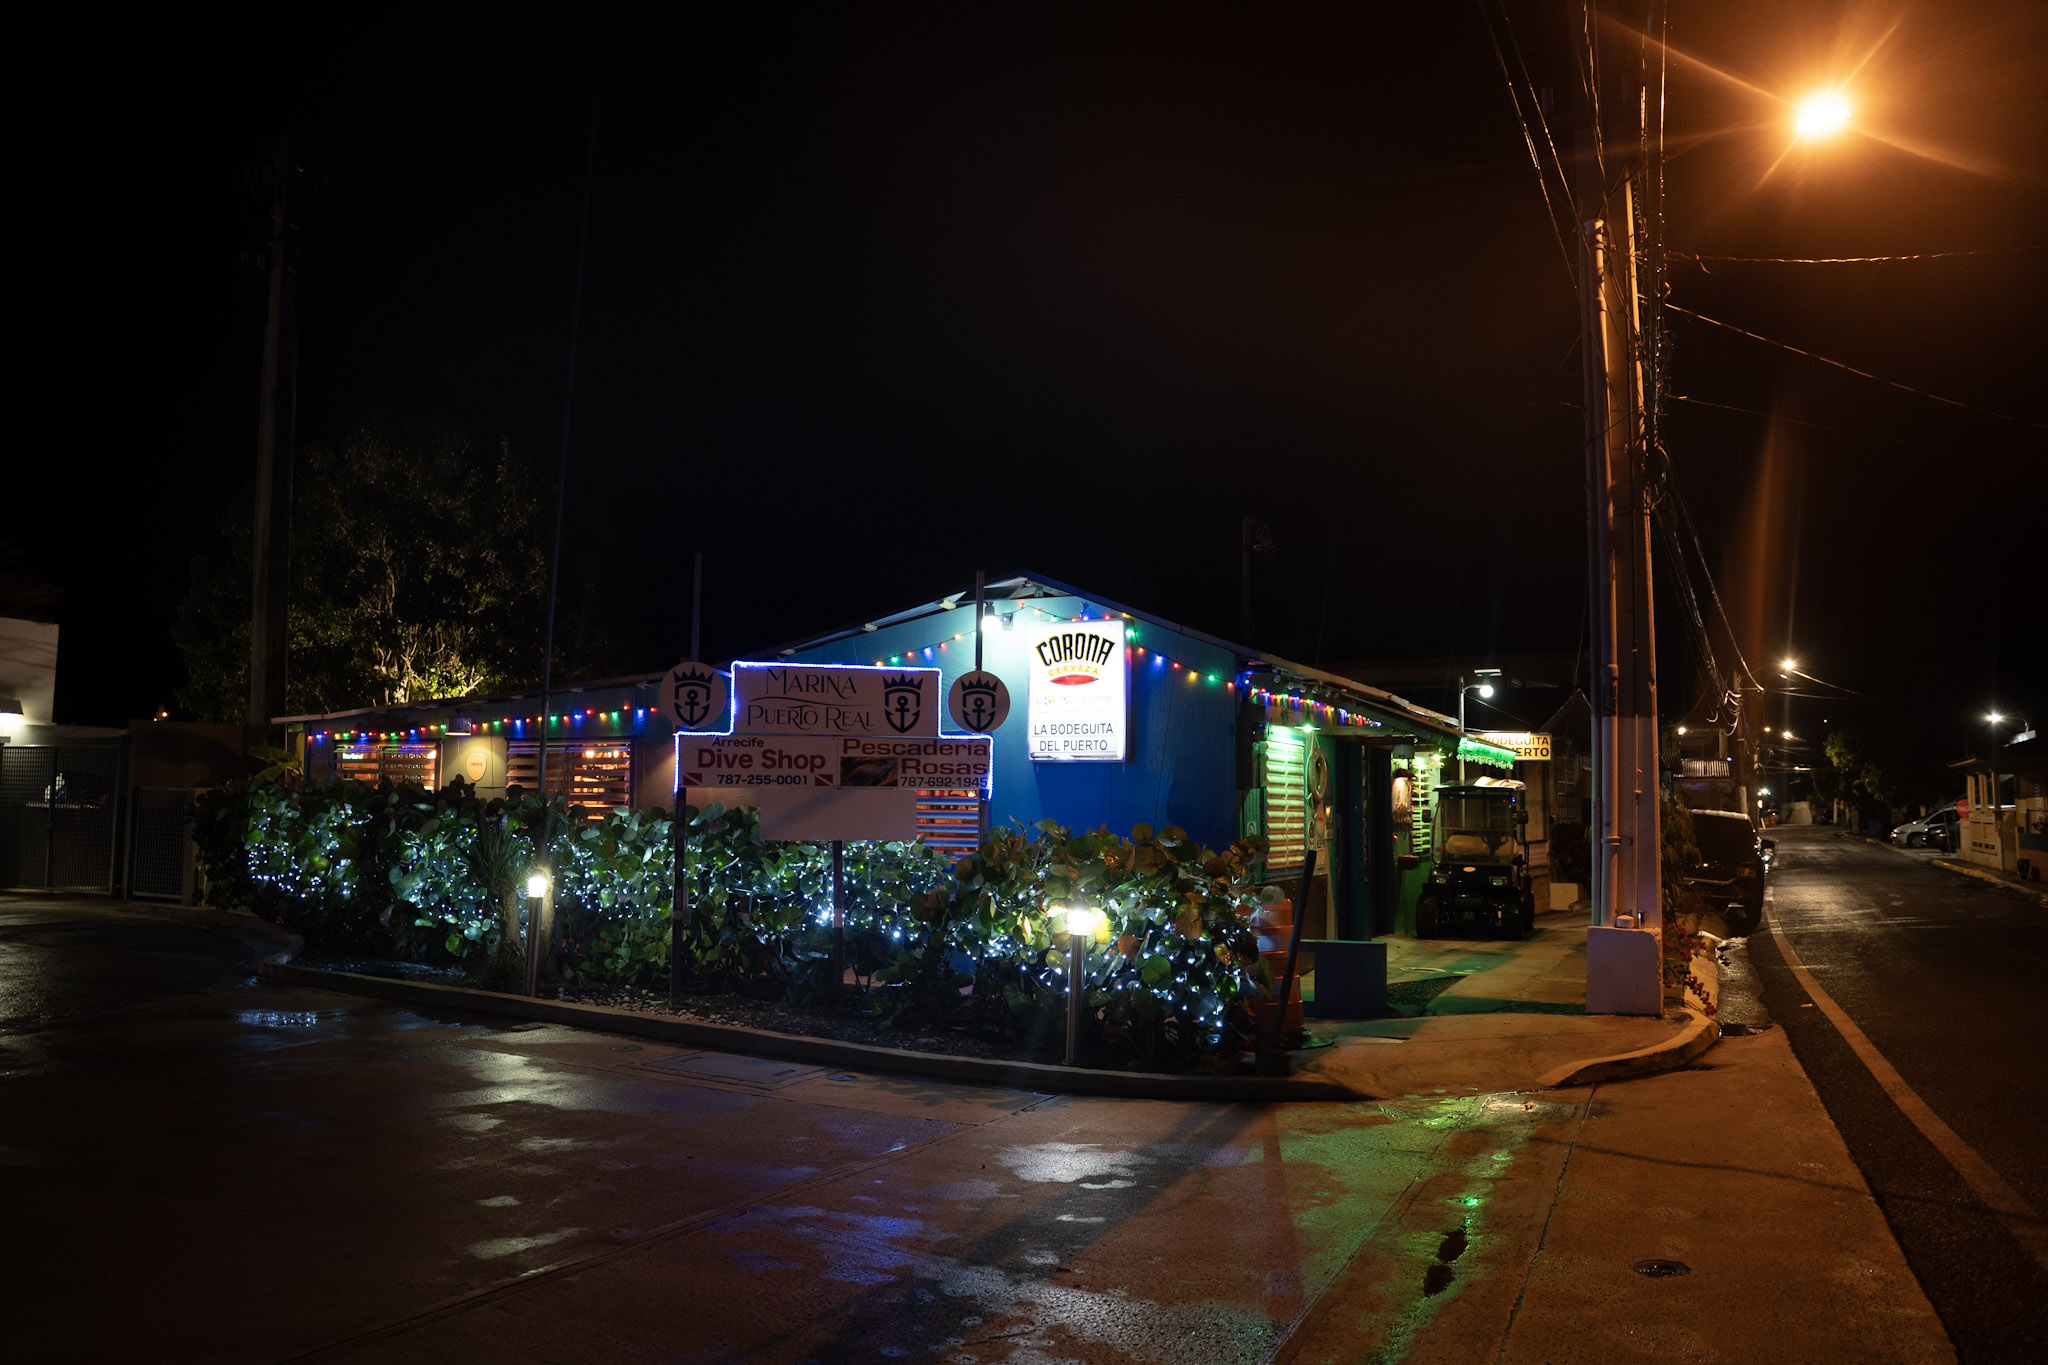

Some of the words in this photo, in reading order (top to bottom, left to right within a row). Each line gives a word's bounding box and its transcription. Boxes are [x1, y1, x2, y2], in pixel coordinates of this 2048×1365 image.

[1035, 632, 1116, 667] CORONA
[1048, 664, 1099, 676] CERVEZA
[766, 668, 857, 699] MARINA
[747, 704, 819, 731] PUERTO
[825, 706, 875, 732] REAL
[1034, 724, 1048, 735] LA
[1050, 723, 1114, 735] BODEGUITA
[712, 737, 765, 748] Arrecife
[842, 738, 988, 756] Pescadería
[1040, 740, 1060, 751] DEL
[1063, 739, 1108, 751] PUERTO
[1511, 747, 1550, 757] ERTO
[697, 748, 754, 769] Dive
[761, 749, 827, 774] Shop
[901, 758, 988, 775] Rosas
[717, 774, 808, 785] 787-255-0001
[901, 776, 989, 787] 787-692-1945
